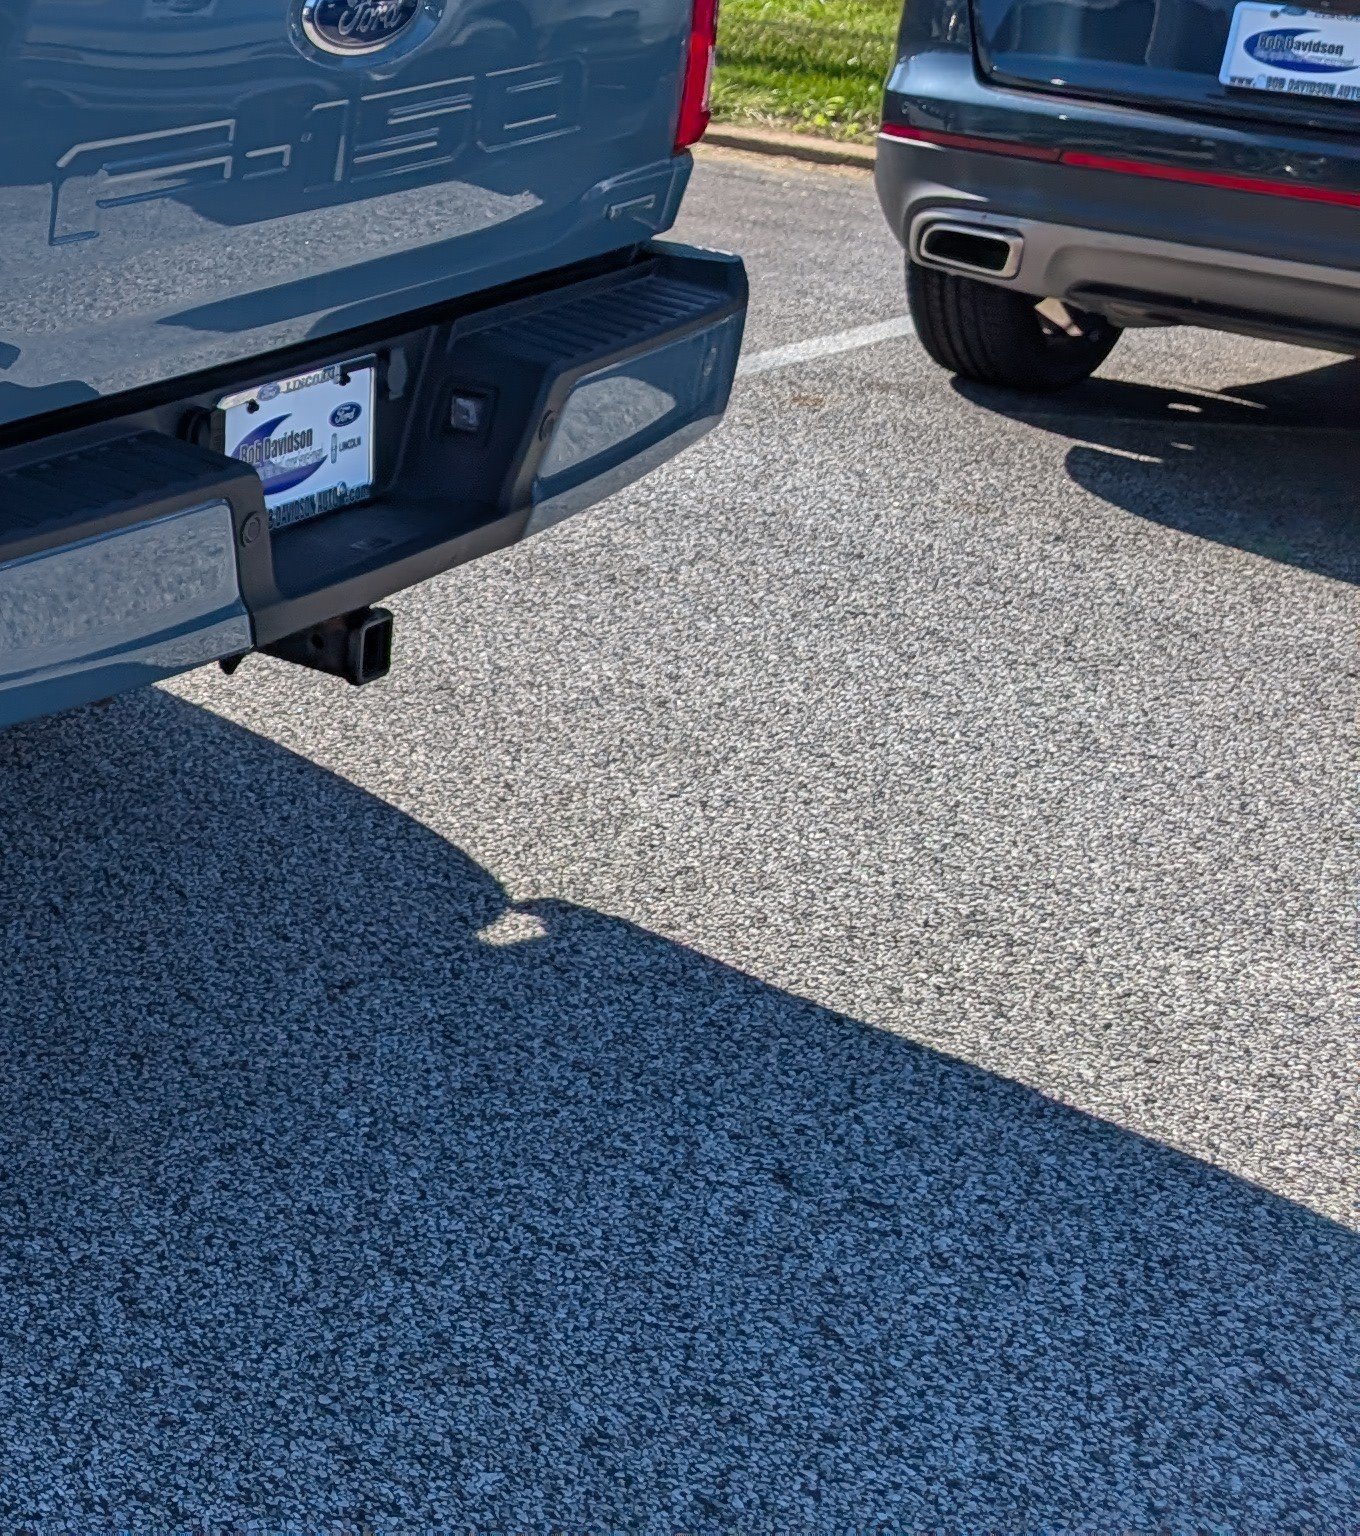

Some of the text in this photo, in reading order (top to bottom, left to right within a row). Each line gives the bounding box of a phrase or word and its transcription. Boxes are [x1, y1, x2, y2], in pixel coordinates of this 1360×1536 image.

[1285, 35, 1344, 56] Davidson
[48, 59, 583, 247] F-150
[333, 404, 358, 425] Ford
[240, 438, 263, 465] Bob
[263, 427, 313, 460] Davidson
[339, 436, 361, 452] LINCOLN
